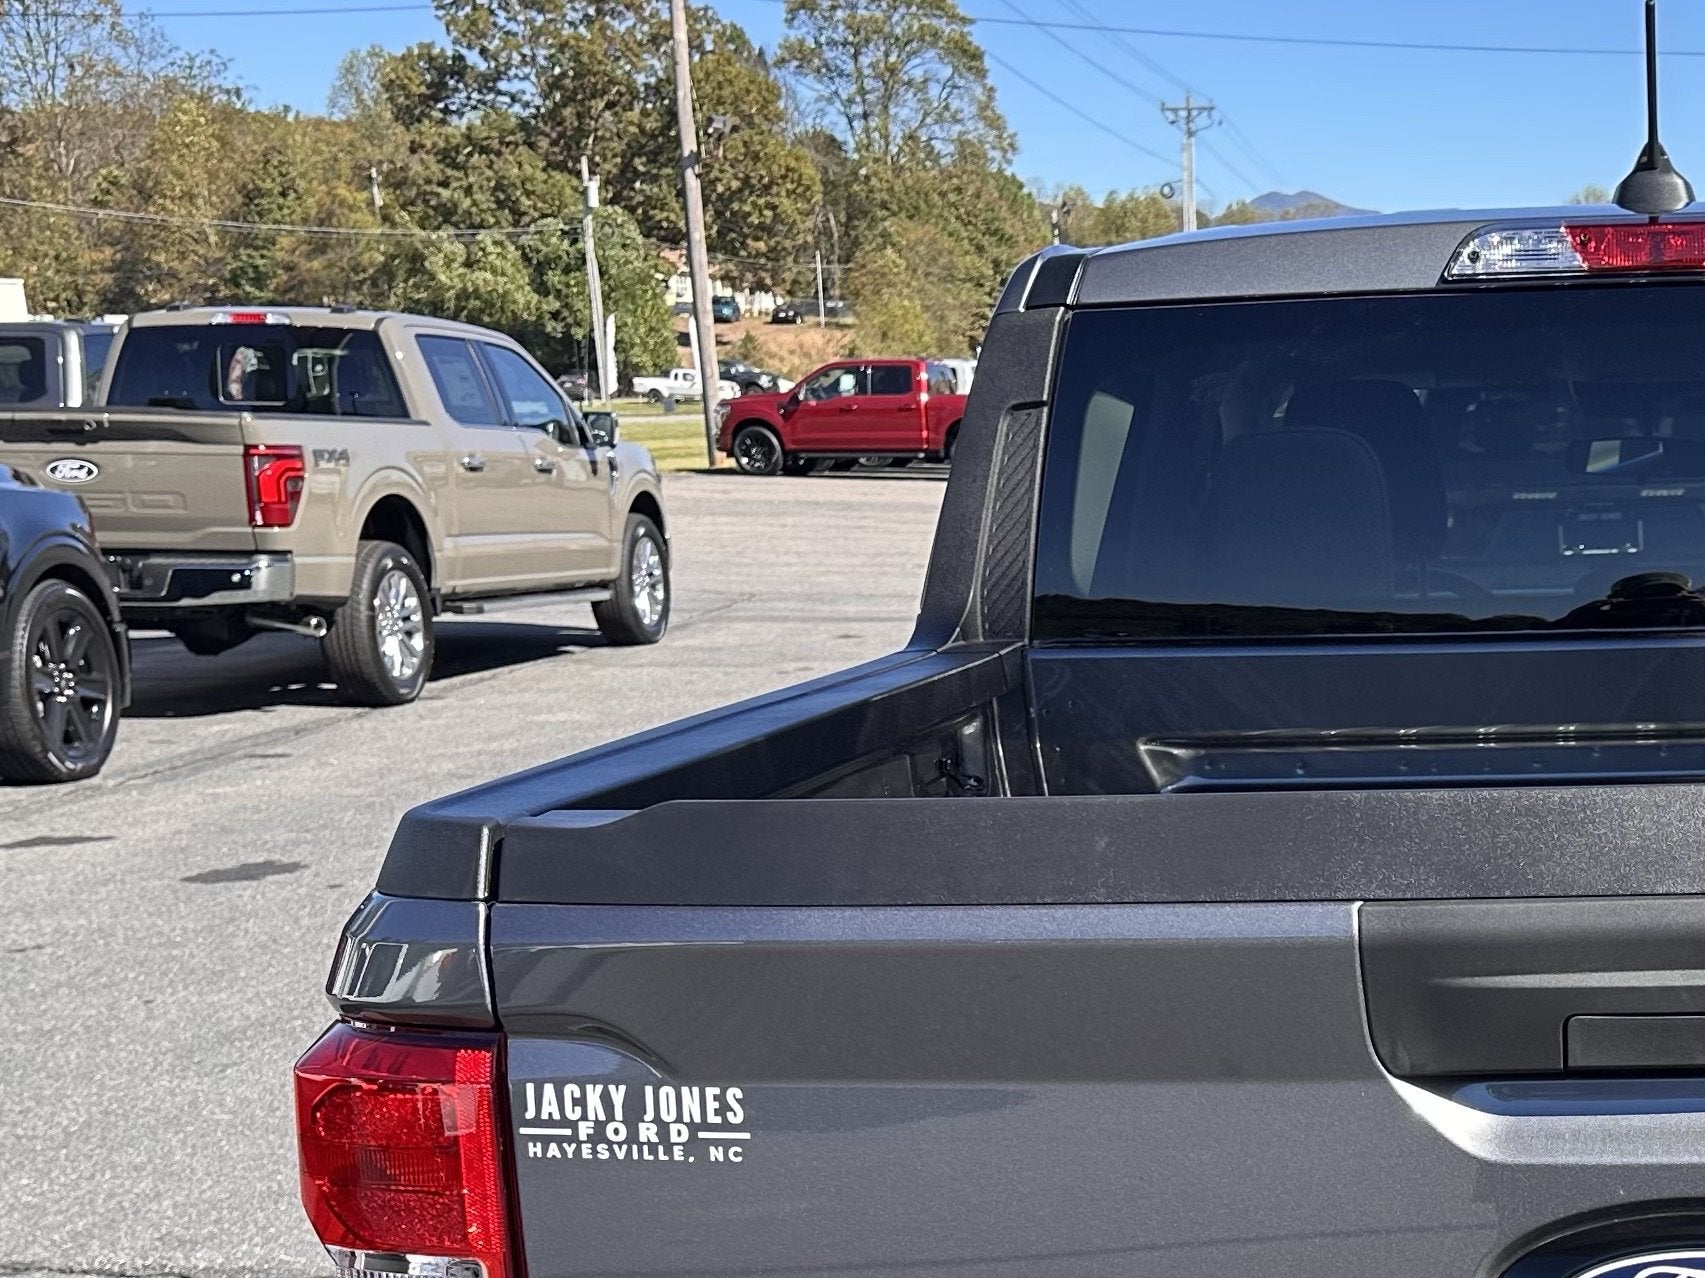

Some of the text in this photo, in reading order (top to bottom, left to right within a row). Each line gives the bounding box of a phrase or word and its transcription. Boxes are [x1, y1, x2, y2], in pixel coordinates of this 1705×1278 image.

[524, 1082, 744, 1124] JACKY JONES
[578, 1121, 690, 1143] FORD
[528, 1142, 743, 1163] HAYESVILLE, NC
